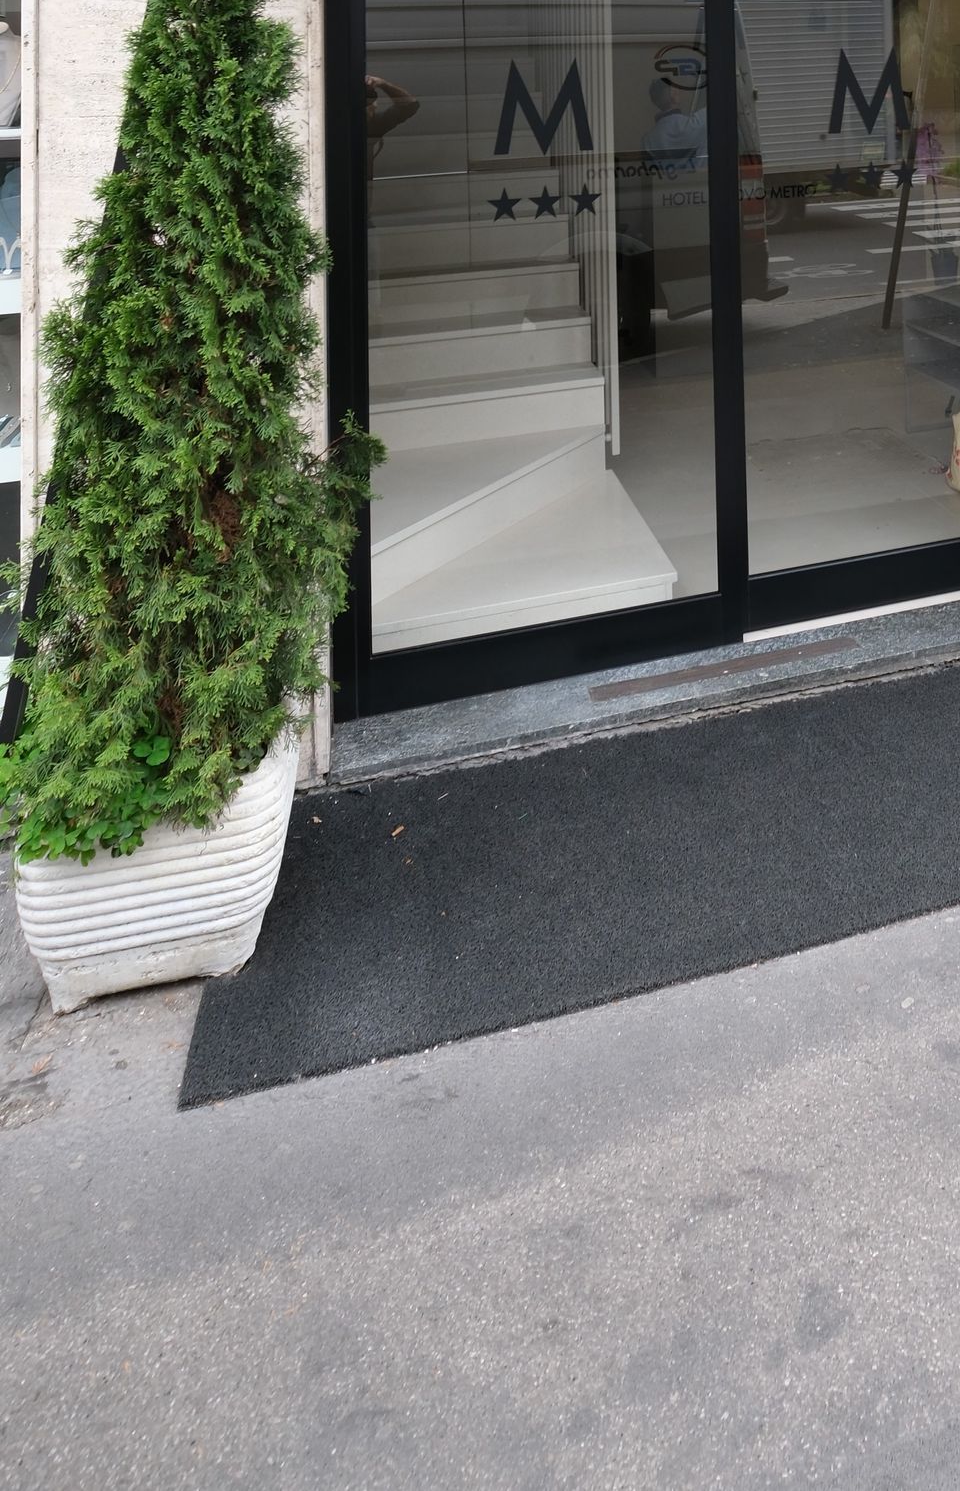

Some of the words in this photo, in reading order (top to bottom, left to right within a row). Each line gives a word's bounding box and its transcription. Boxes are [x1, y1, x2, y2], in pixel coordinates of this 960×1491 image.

[494, 58, 594, 156] M
[828, 47, 911, 135] M
[662, 191, 708, 206] HOTEL
